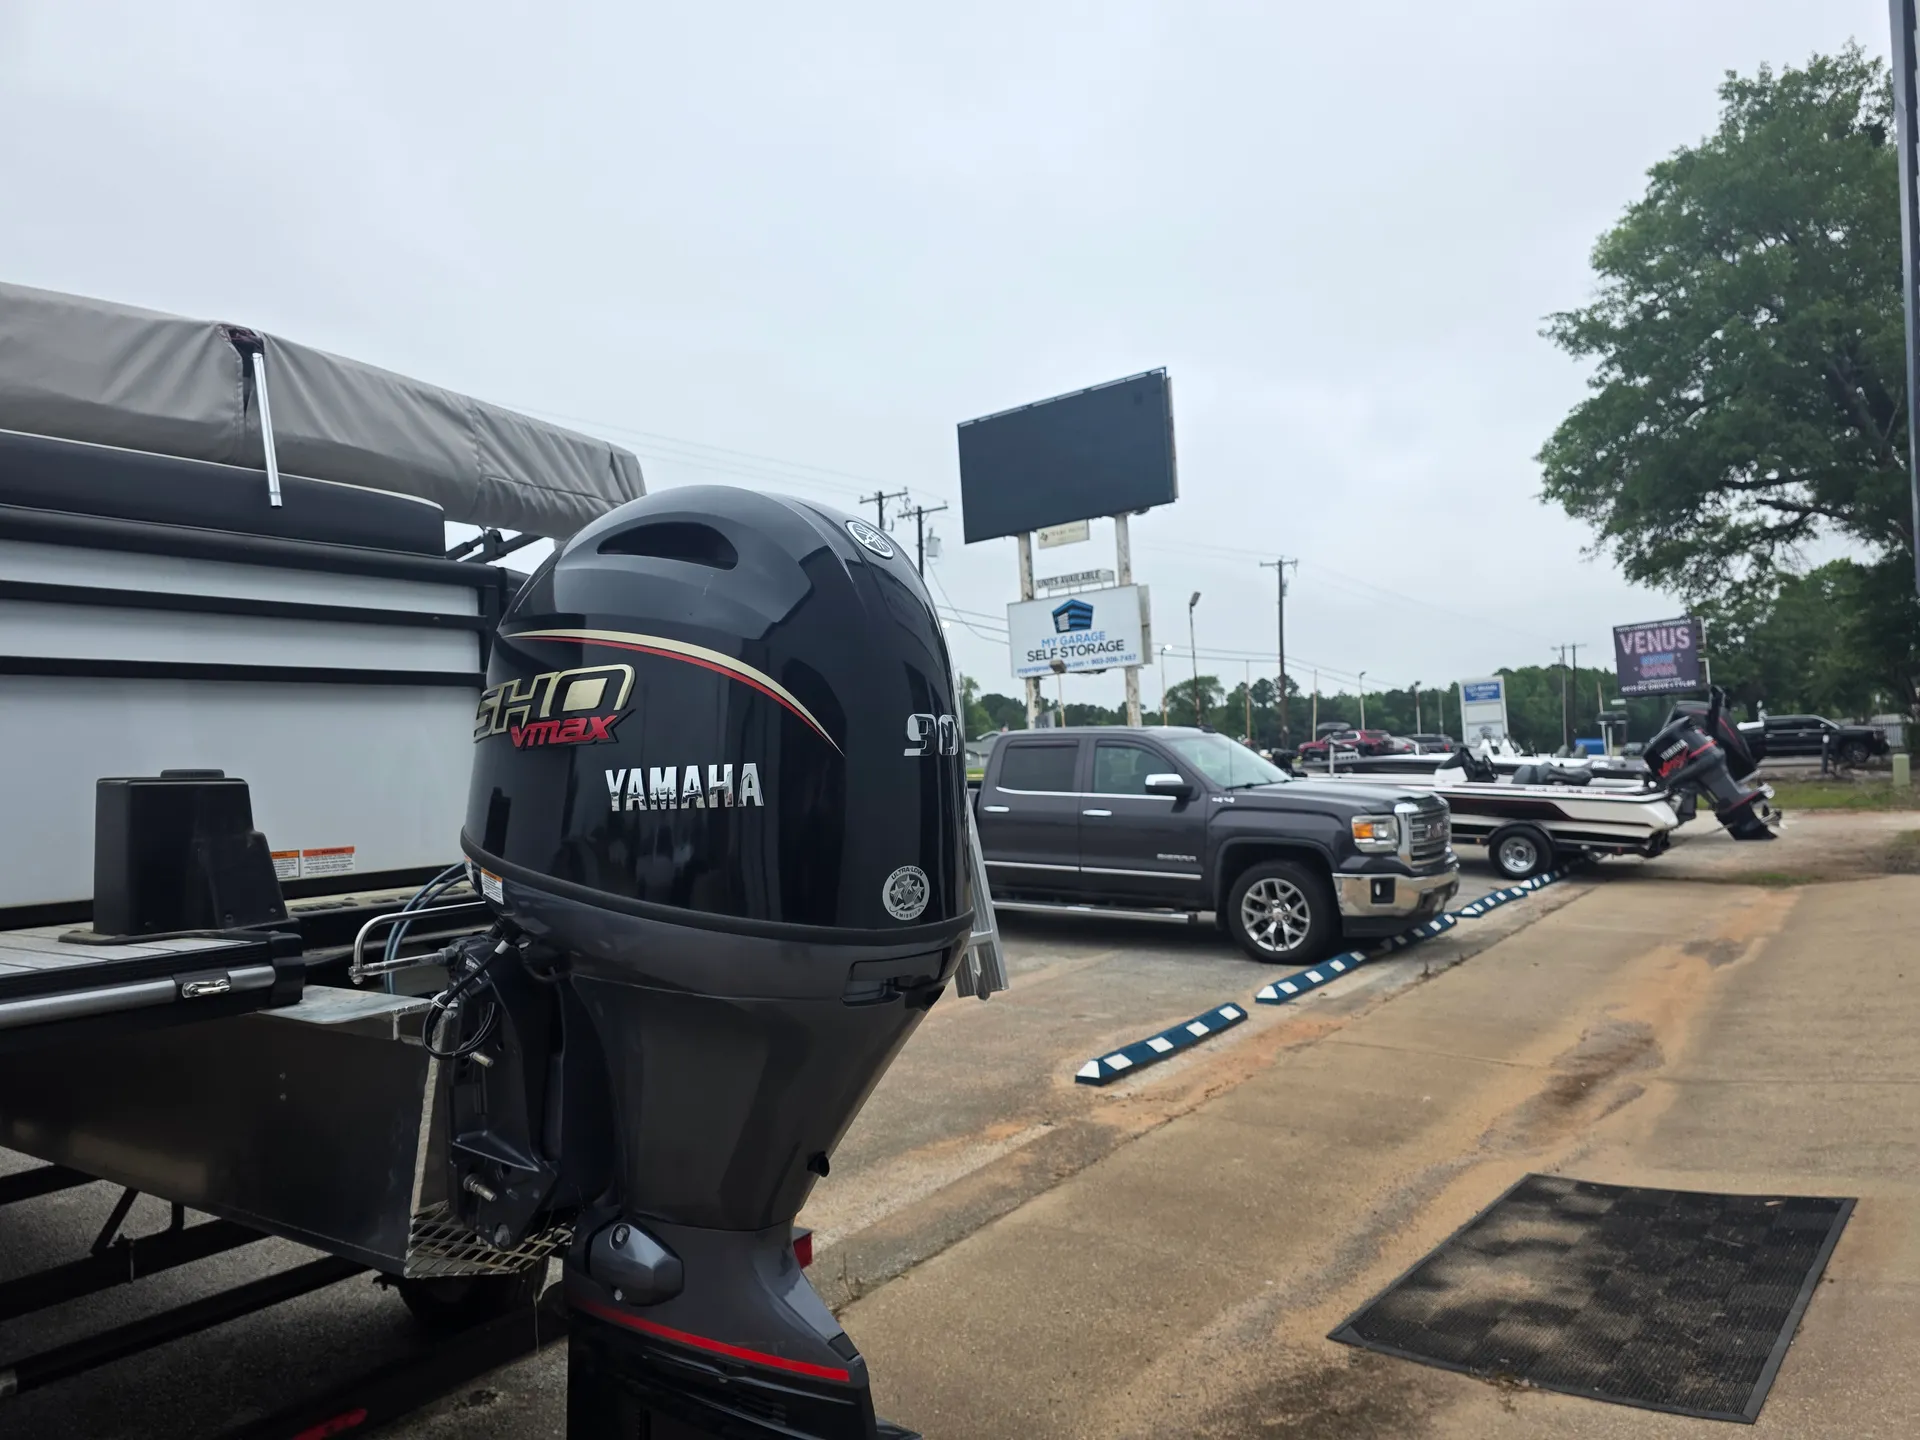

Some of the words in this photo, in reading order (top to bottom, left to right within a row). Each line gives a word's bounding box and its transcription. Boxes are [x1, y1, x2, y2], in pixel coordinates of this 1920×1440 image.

[1036, 577, 1058, 589] UNITS
[1060, 570, 1101, 584] AVAILABLE
[1027, 648, 1058, 662] SELF
[1059, 639, 1125, 658] STORAGE
[1041, 638, 1058, 648] MY
[1060, 631, 1106, 646] GARAGE
[1619, 626, 1691, 655] VENUS
[903, 713, 959, 756] 90
[605, 762, 764, 812] YAMAHA
